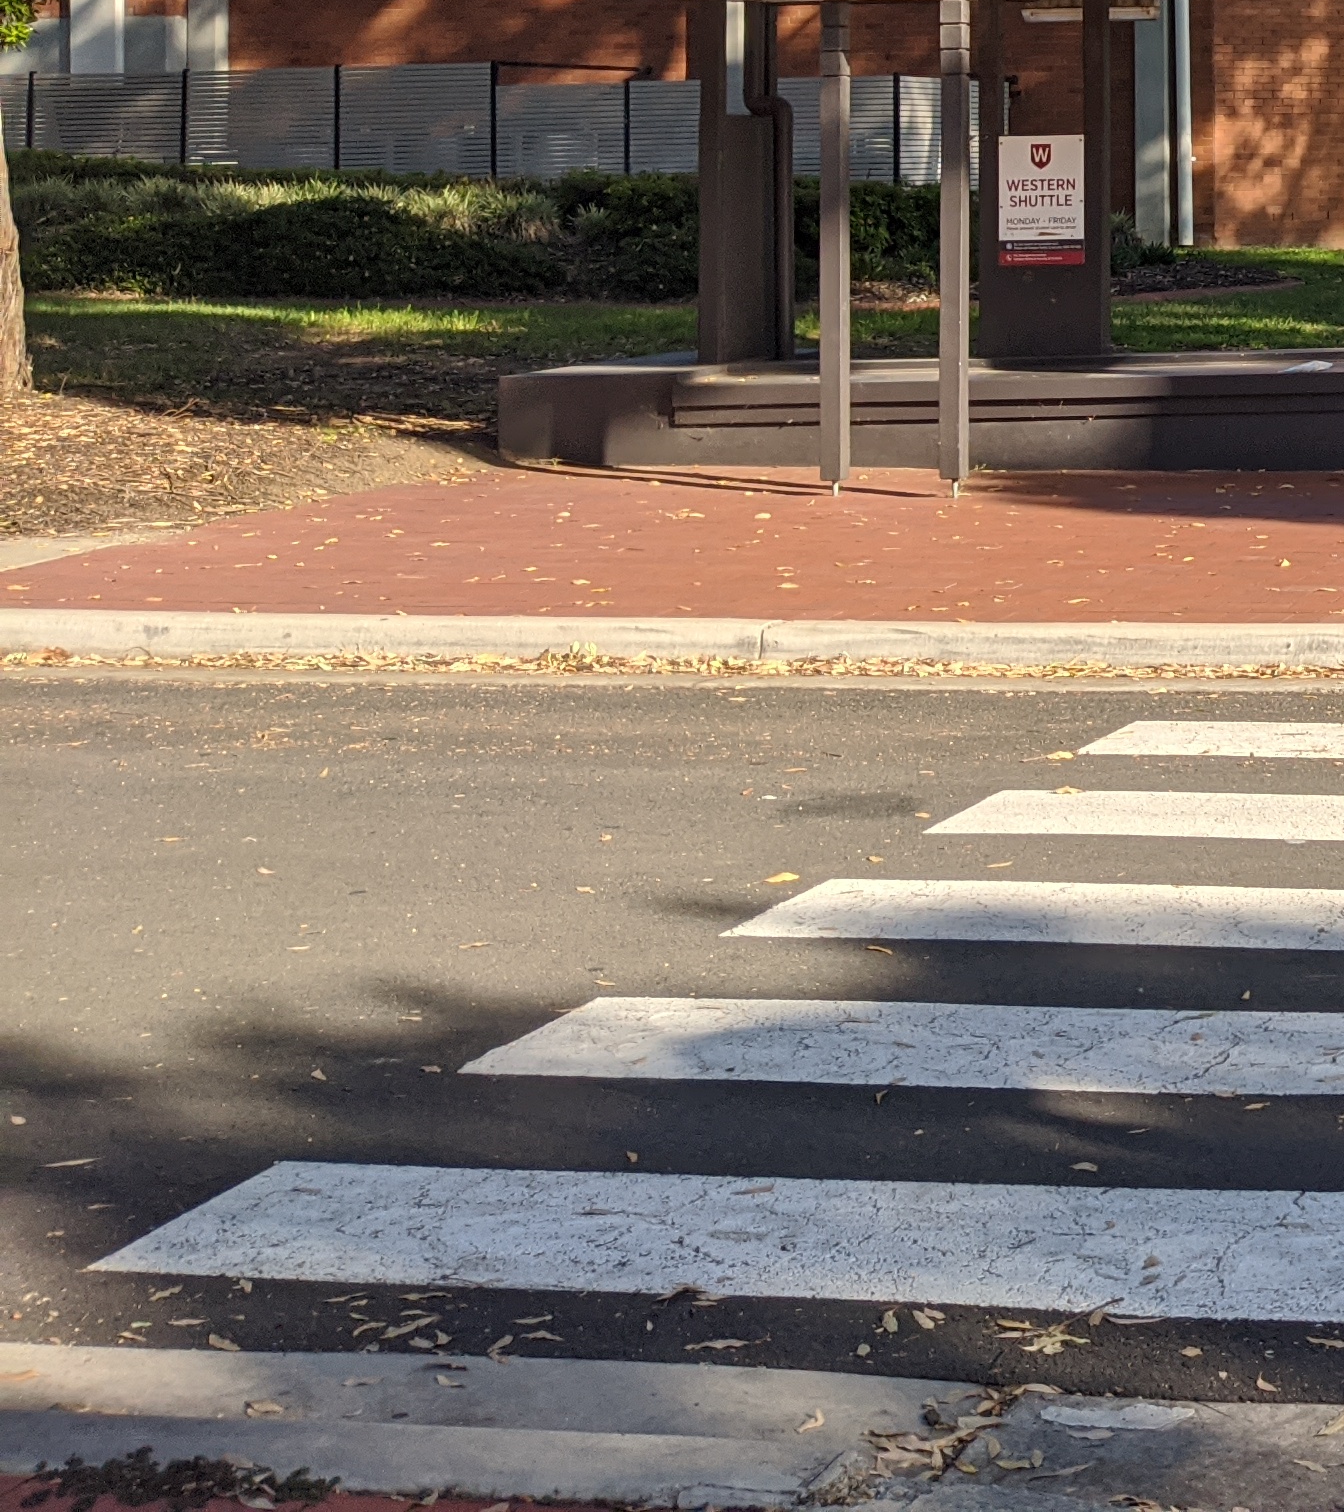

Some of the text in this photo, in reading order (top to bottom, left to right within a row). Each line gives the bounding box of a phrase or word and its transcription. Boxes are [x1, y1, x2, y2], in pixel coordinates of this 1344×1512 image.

[1032, 147, 1049, 163] W
[1006, 178, 1076, 192] WESTERN
[1009, 194, 1073, 208] SHUTTLE
[1006, 217, 1041, 226] MONDAY
[1048, 216, 1077, 224] FRIDAY
